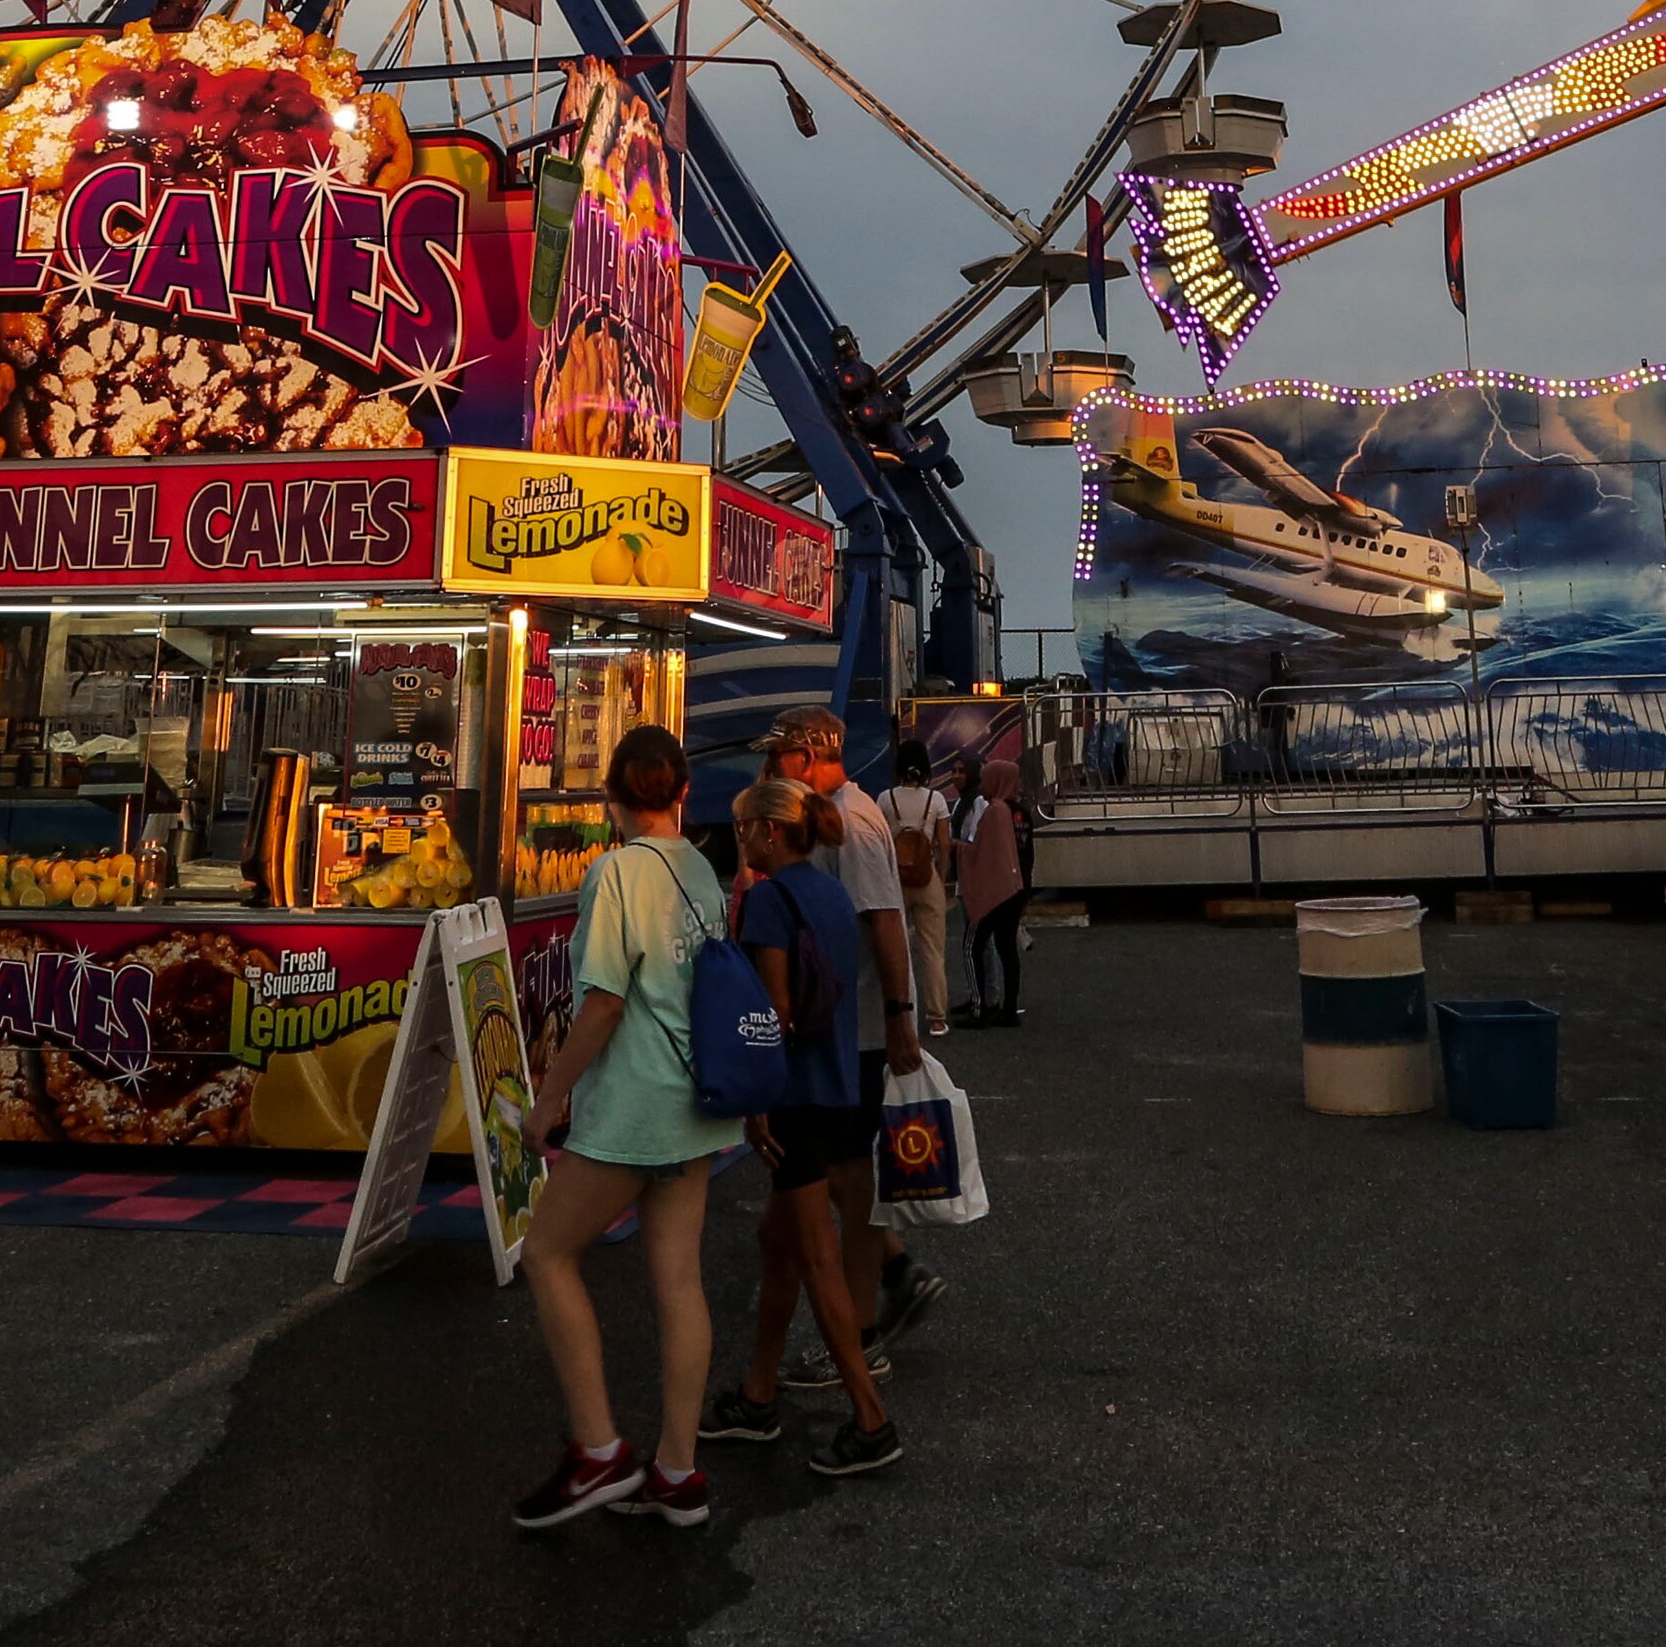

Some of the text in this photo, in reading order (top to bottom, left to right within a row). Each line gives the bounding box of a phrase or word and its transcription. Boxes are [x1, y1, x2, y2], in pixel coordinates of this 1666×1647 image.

[61, 164, 466, 382] CAKES
[520, 473, 570, 498] Fresh
[503, 488, 579, 518] Squeezed
[1197, 511, 1223, 524] DD407
[185, 478, 412, 569] CAKES
[468, 488, 690, 573] Lemonade
[717, 500, 828, 611] FUNNEL CAKES
[532, 631, 550, 666] WE
[396, 676, 417, 688] $10
[524, 676, 555, 715] WRAP
[356, 743, 374, 752] ICE
[377, 743, 412, 752] COLD
[358, 754, 409, 763] DRINKS
[280, 947, 326, 973] Fresh
[263, 967, 336, 999] Squeezed
[229, 969, 413, 1066] Lemonad
